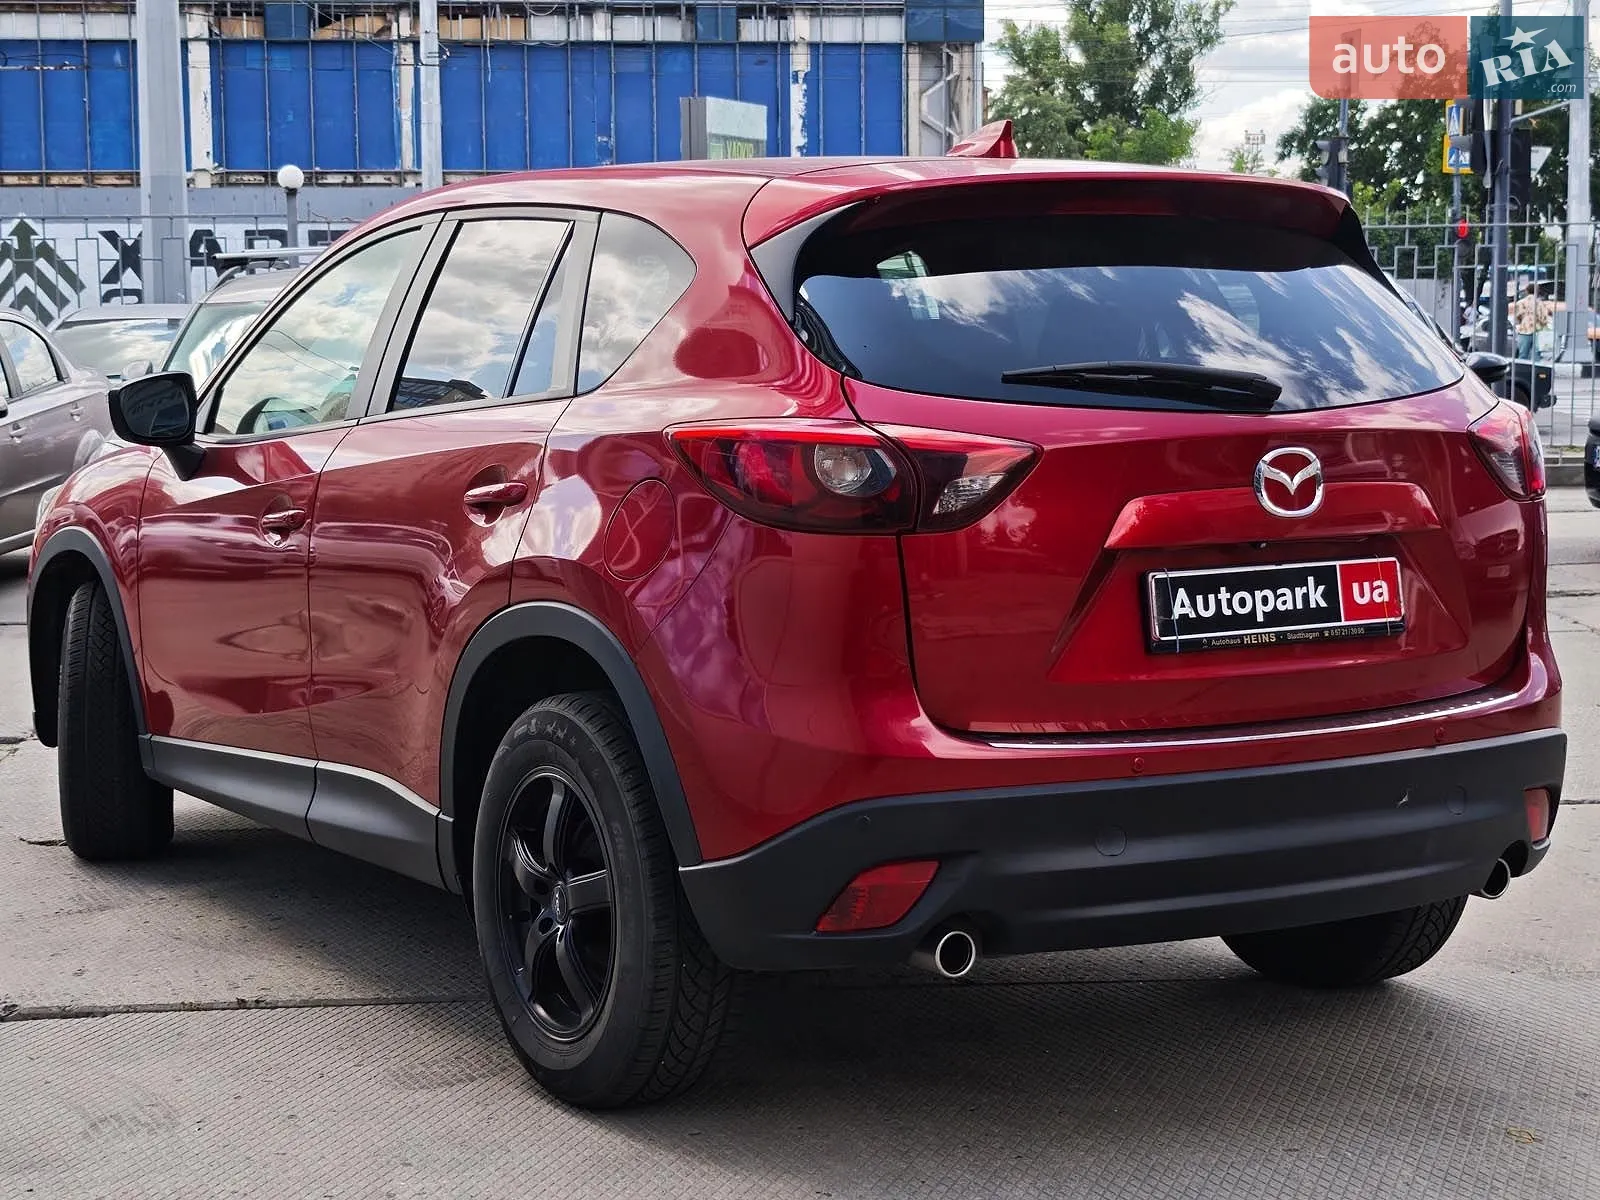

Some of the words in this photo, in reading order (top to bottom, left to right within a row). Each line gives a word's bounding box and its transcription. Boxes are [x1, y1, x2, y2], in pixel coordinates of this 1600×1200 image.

[1171, 576, 1329, 622] Autopark
[1351, 579, 1389, 605] ua
[1211, 637, 1241, 646] Autohaus
[1243, 633, 1277, 645] HEINS
[1286, 631, 1320, 640] Stadthagen
